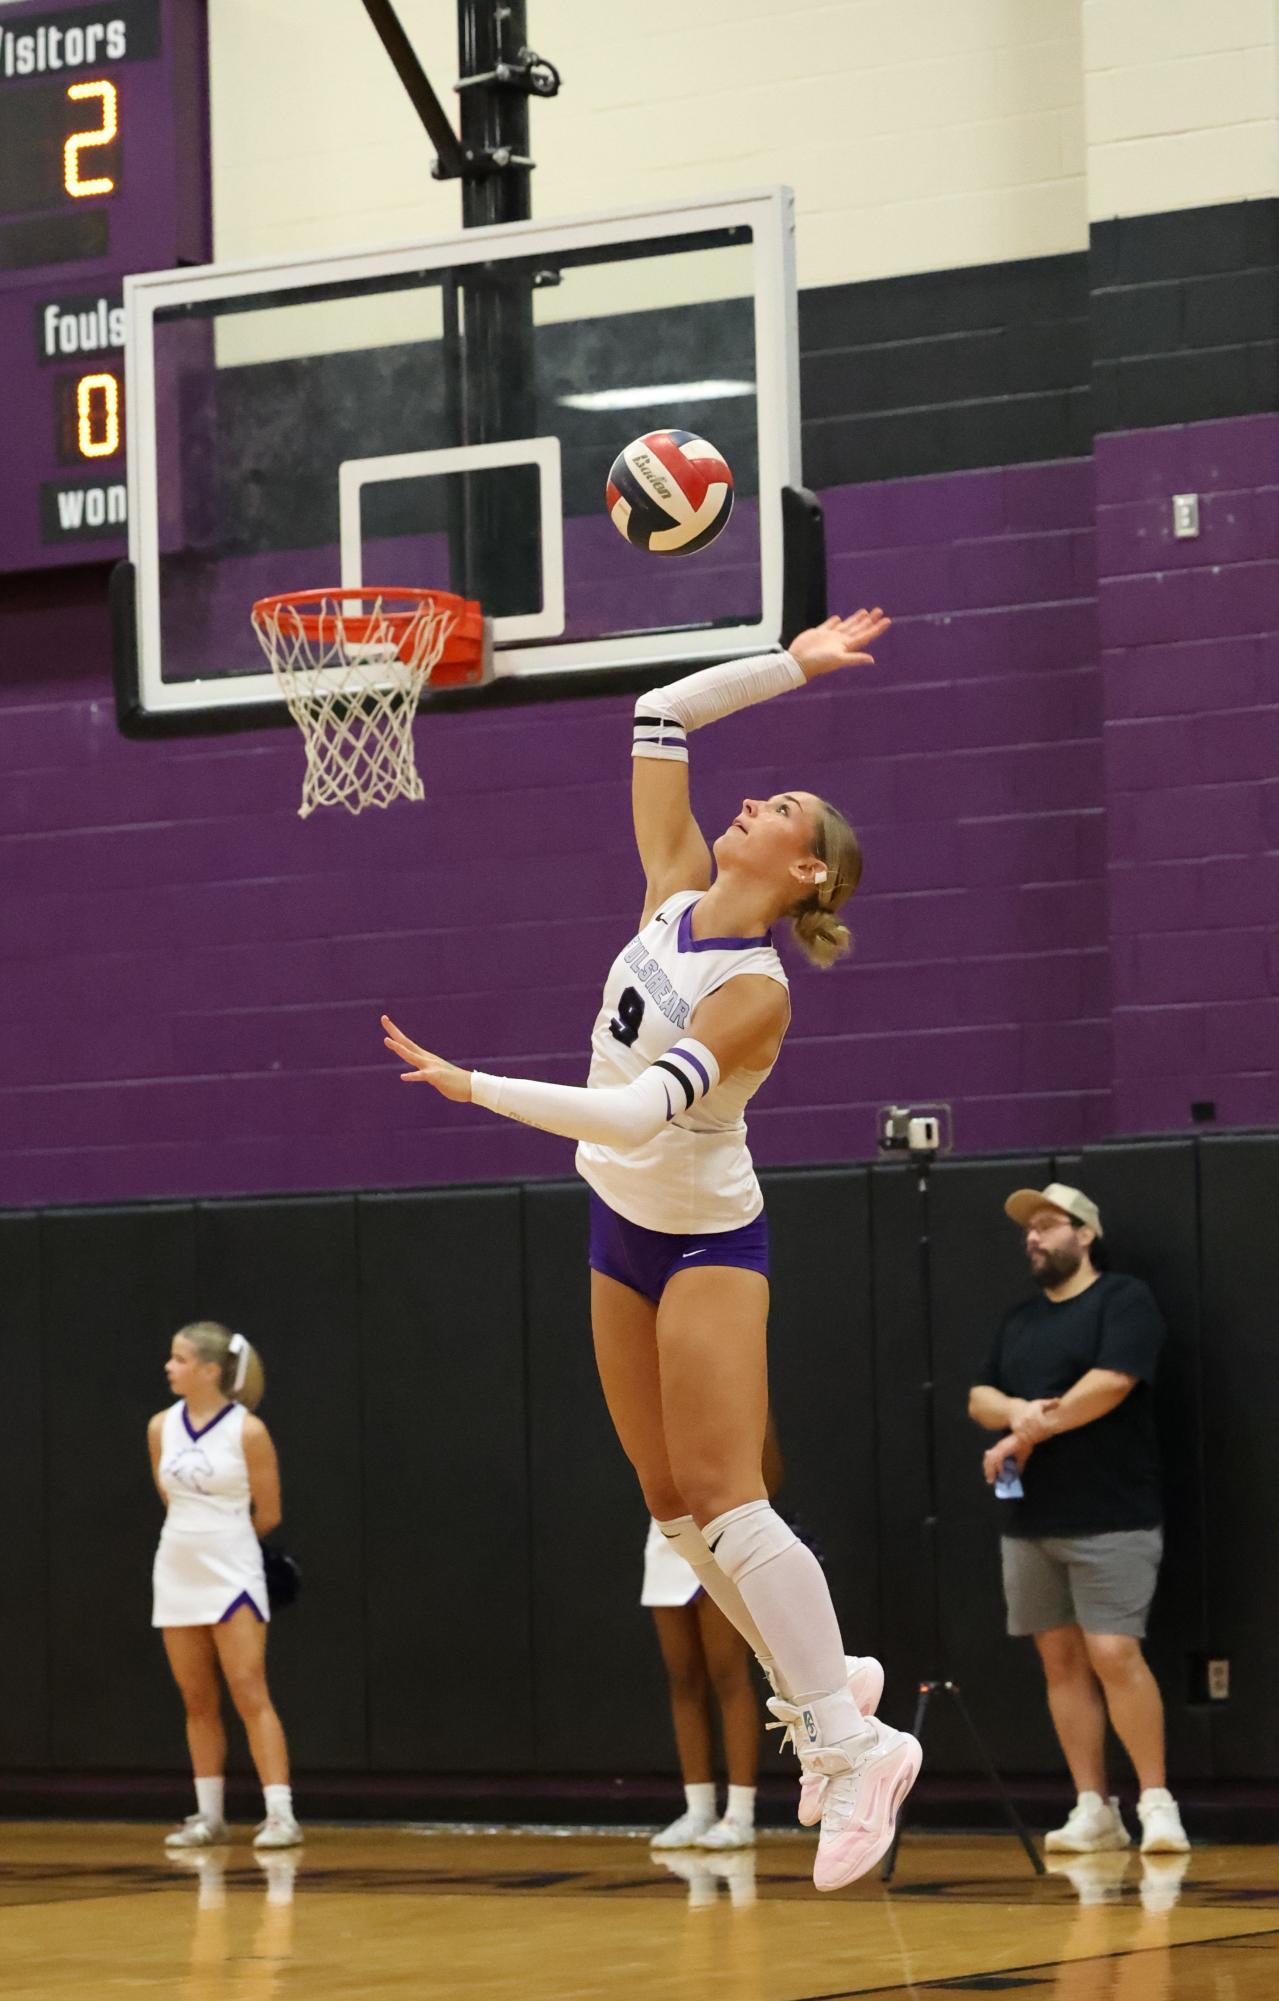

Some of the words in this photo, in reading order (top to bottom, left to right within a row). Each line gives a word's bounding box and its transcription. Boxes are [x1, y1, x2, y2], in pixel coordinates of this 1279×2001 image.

[0, 20, 126, 77] isitors
[64, 80, 117, 197] 2
[44, 298, 127, 356] fouls
[77, 373, 119, 457] 0
[632, 454, 672, 500] Baden
[57, 485, 127, 530] won
[608, 986, 645, 1048] 9
